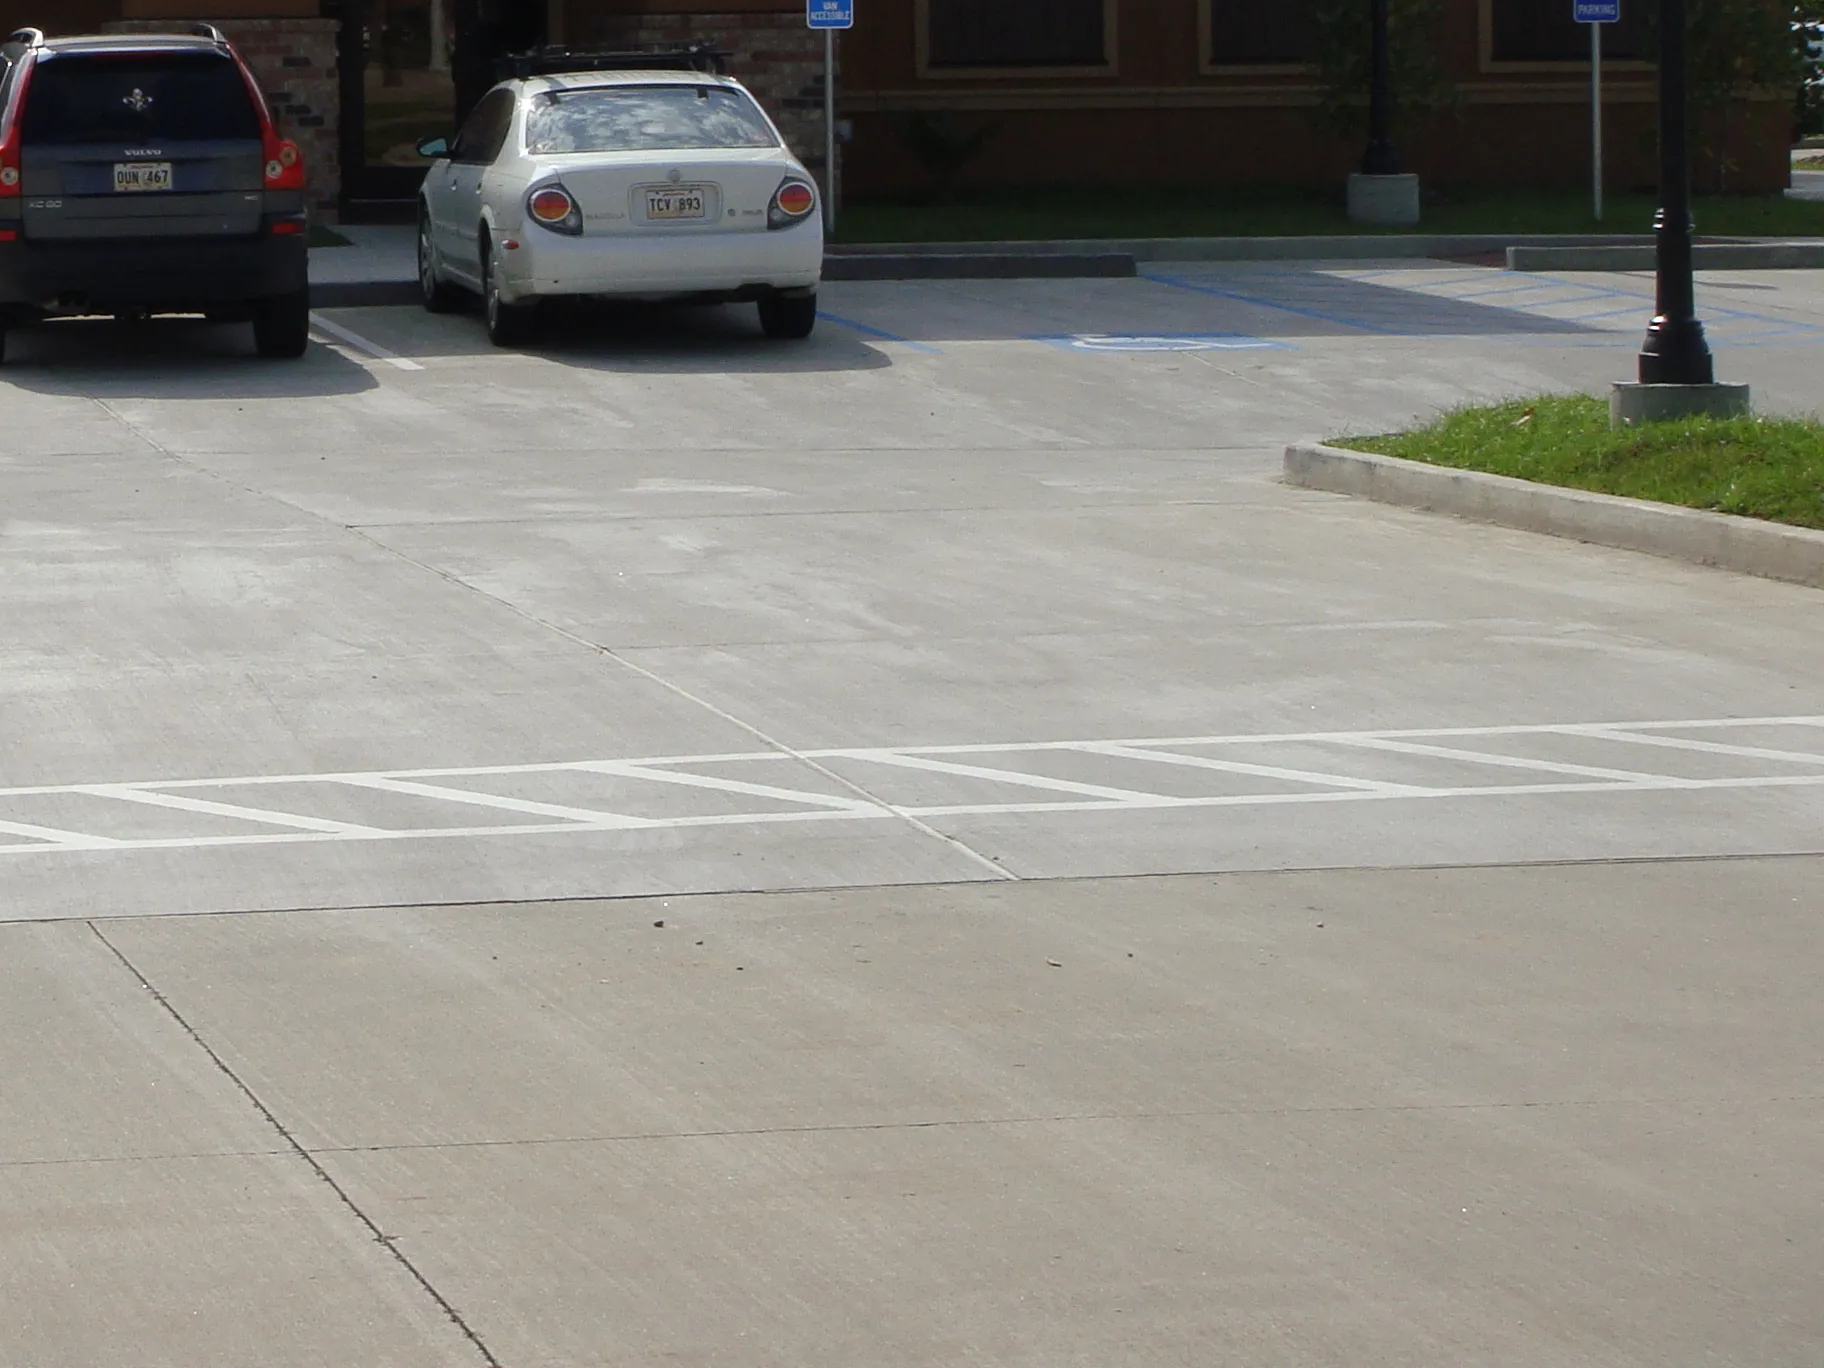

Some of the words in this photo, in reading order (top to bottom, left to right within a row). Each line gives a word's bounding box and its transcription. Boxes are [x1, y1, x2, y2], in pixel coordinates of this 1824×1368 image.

[823, 1, 838, 11] VAN
[1577, 4, 1616, 15] PARKING
[810, 10, 850, 20] ACCESSIBLE
[147, 169, 168, 184] 467
[679, 197, 701, 211] 893
